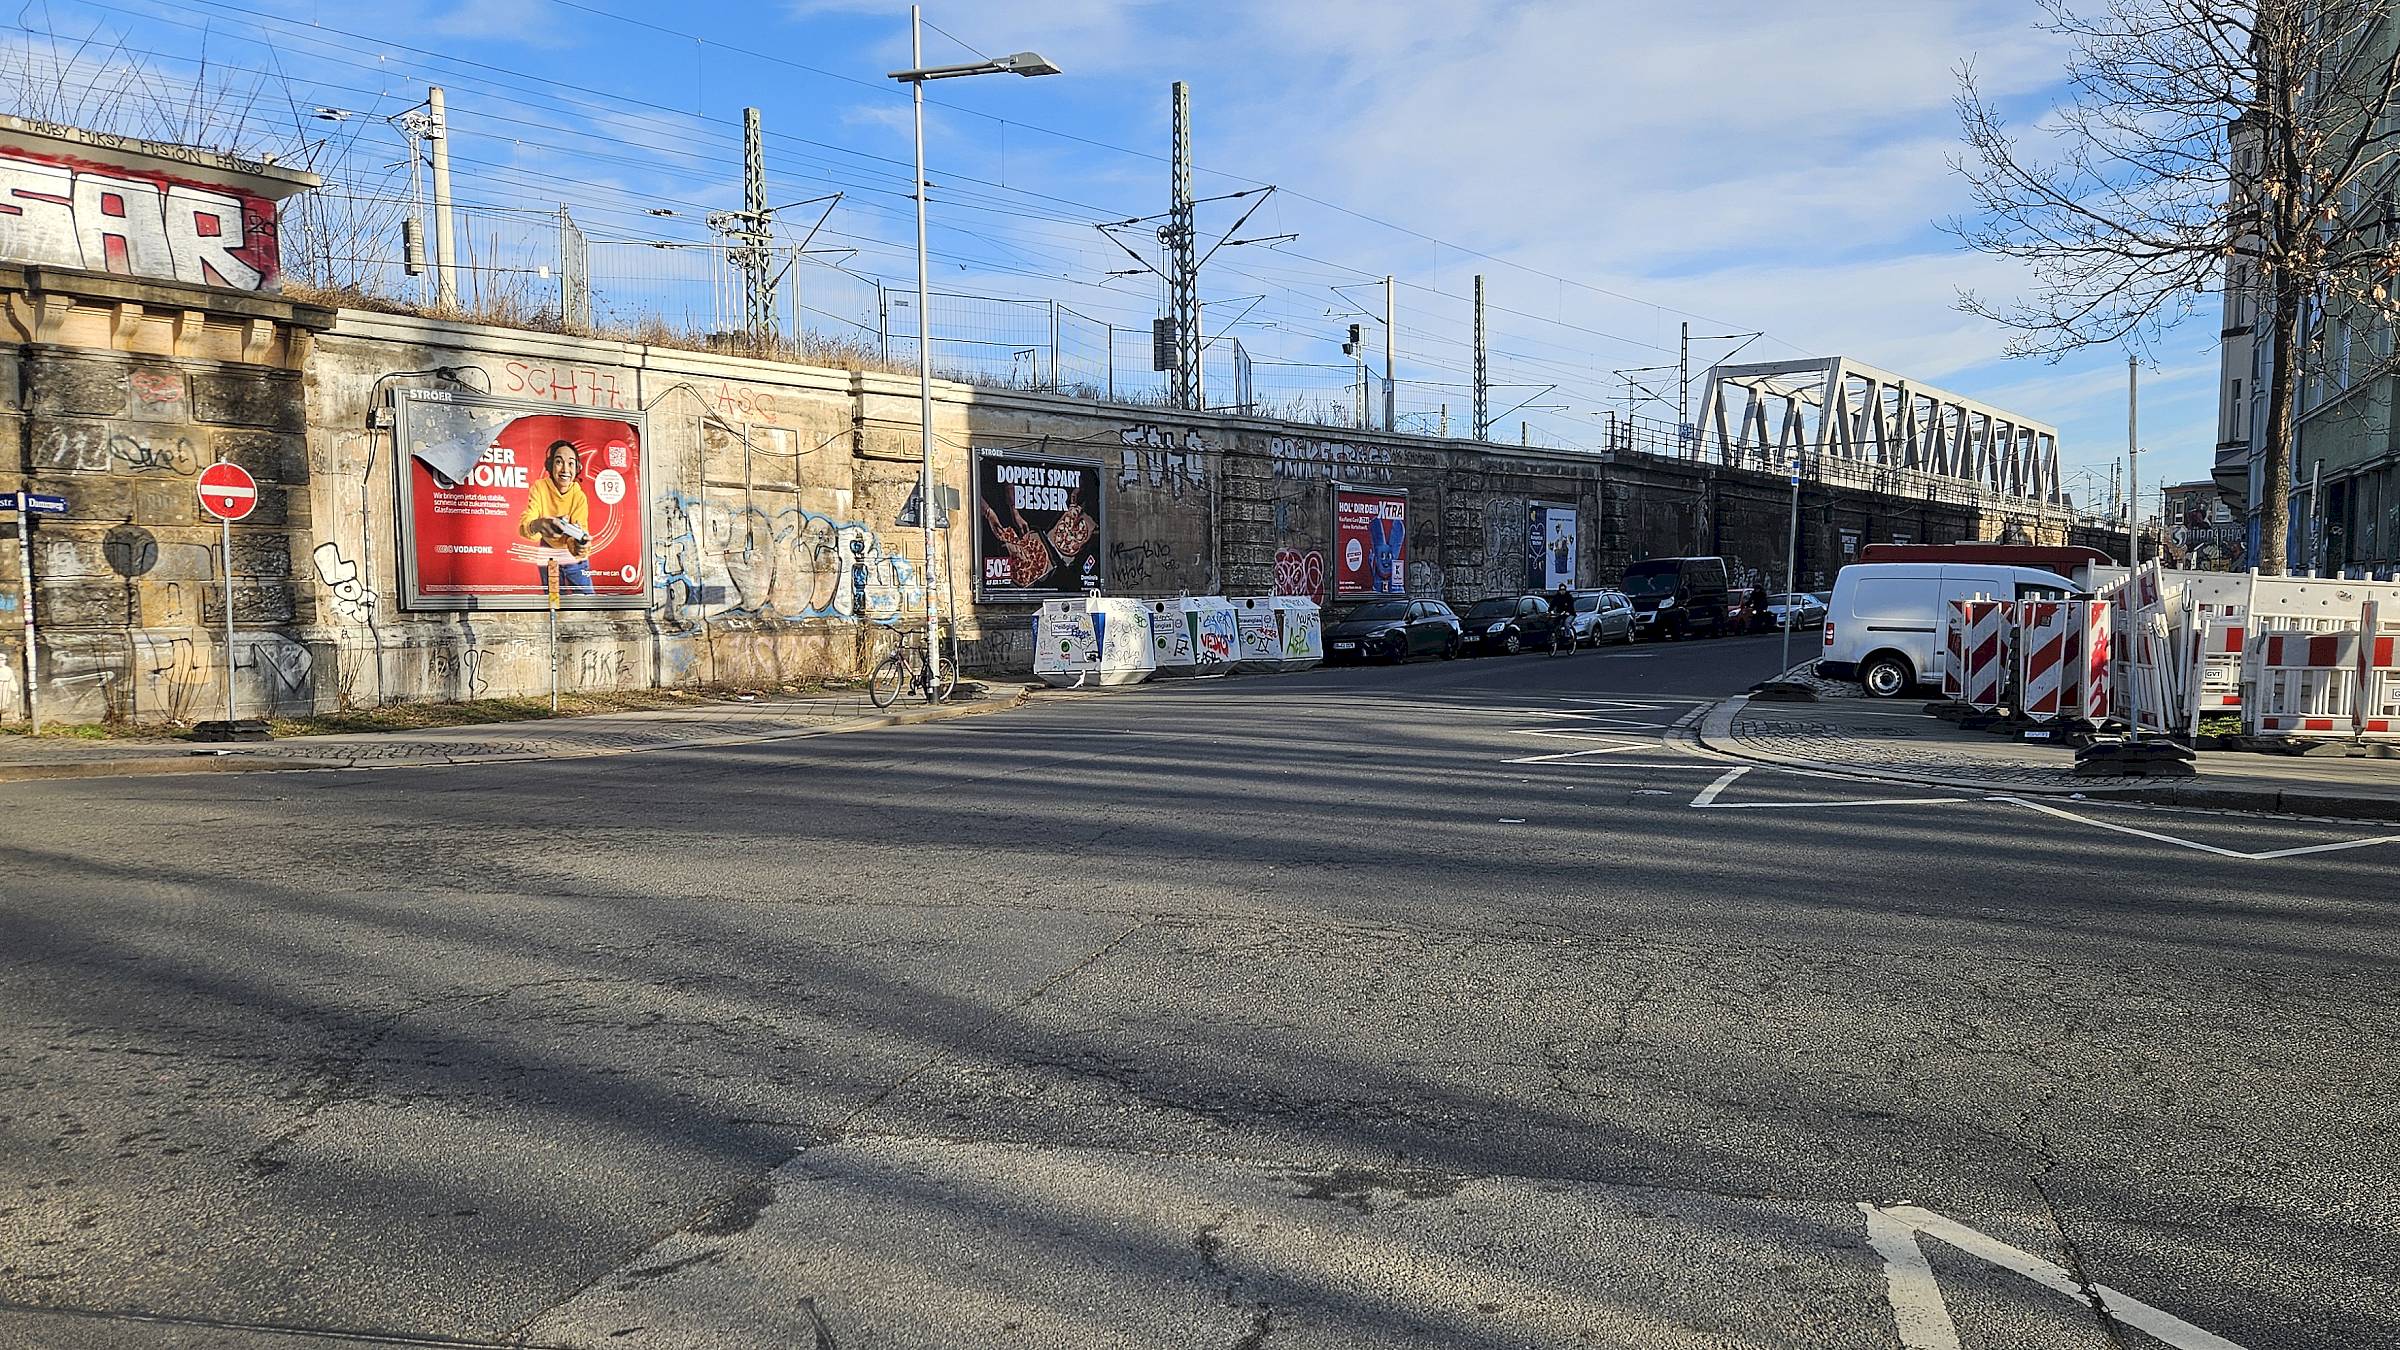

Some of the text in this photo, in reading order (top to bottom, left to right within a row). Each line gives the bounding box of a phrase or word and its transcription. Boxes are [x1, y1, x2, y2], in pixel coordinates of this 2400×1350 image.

[997, 465, 1081, 488] DOPPELT SPART
[1014, 485, 1069, 512] BESSER
[453, 545, 493, 554] VODAFONE
